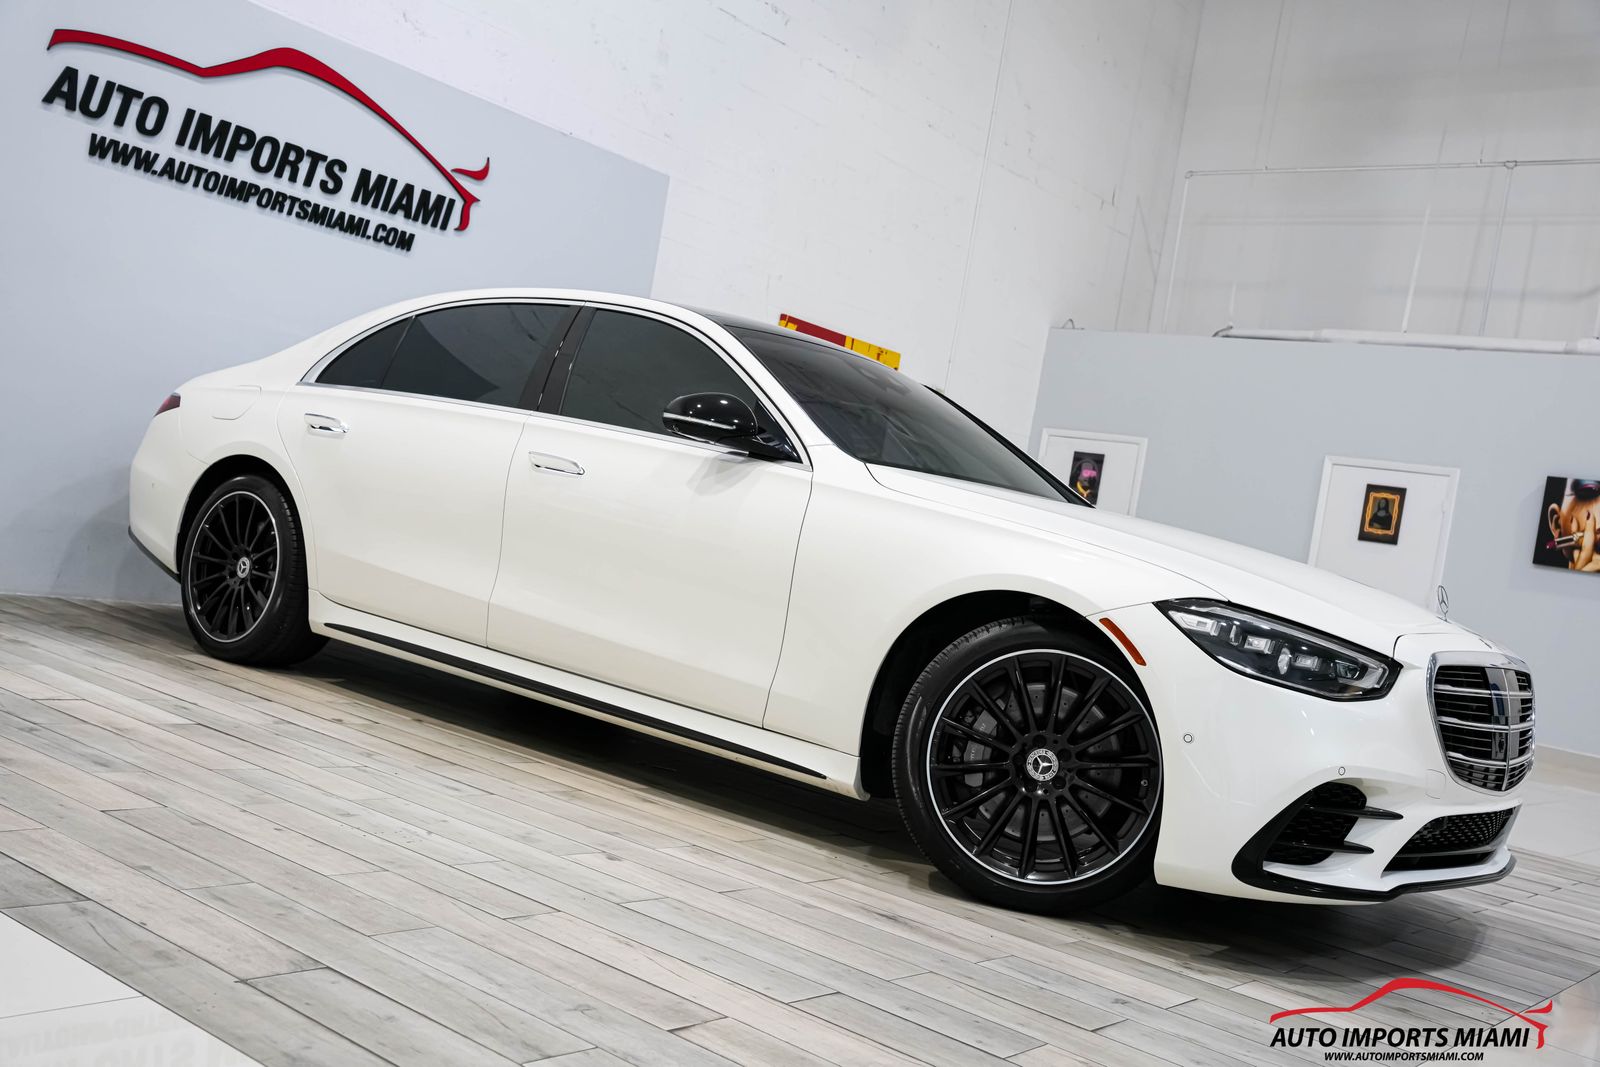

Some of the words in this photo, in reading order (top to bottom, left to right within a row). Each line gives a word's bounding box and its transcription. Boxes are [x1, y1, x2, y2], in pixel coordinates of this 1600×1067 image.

[42, 66, 169, 137] AUTO
[175, 107, 349, 195] IMPORTS
[351, 168, 456, 231] MIAMI
[88, 133, 415, 252] WWW.AUTOIMPORTSMIAMI.COM
